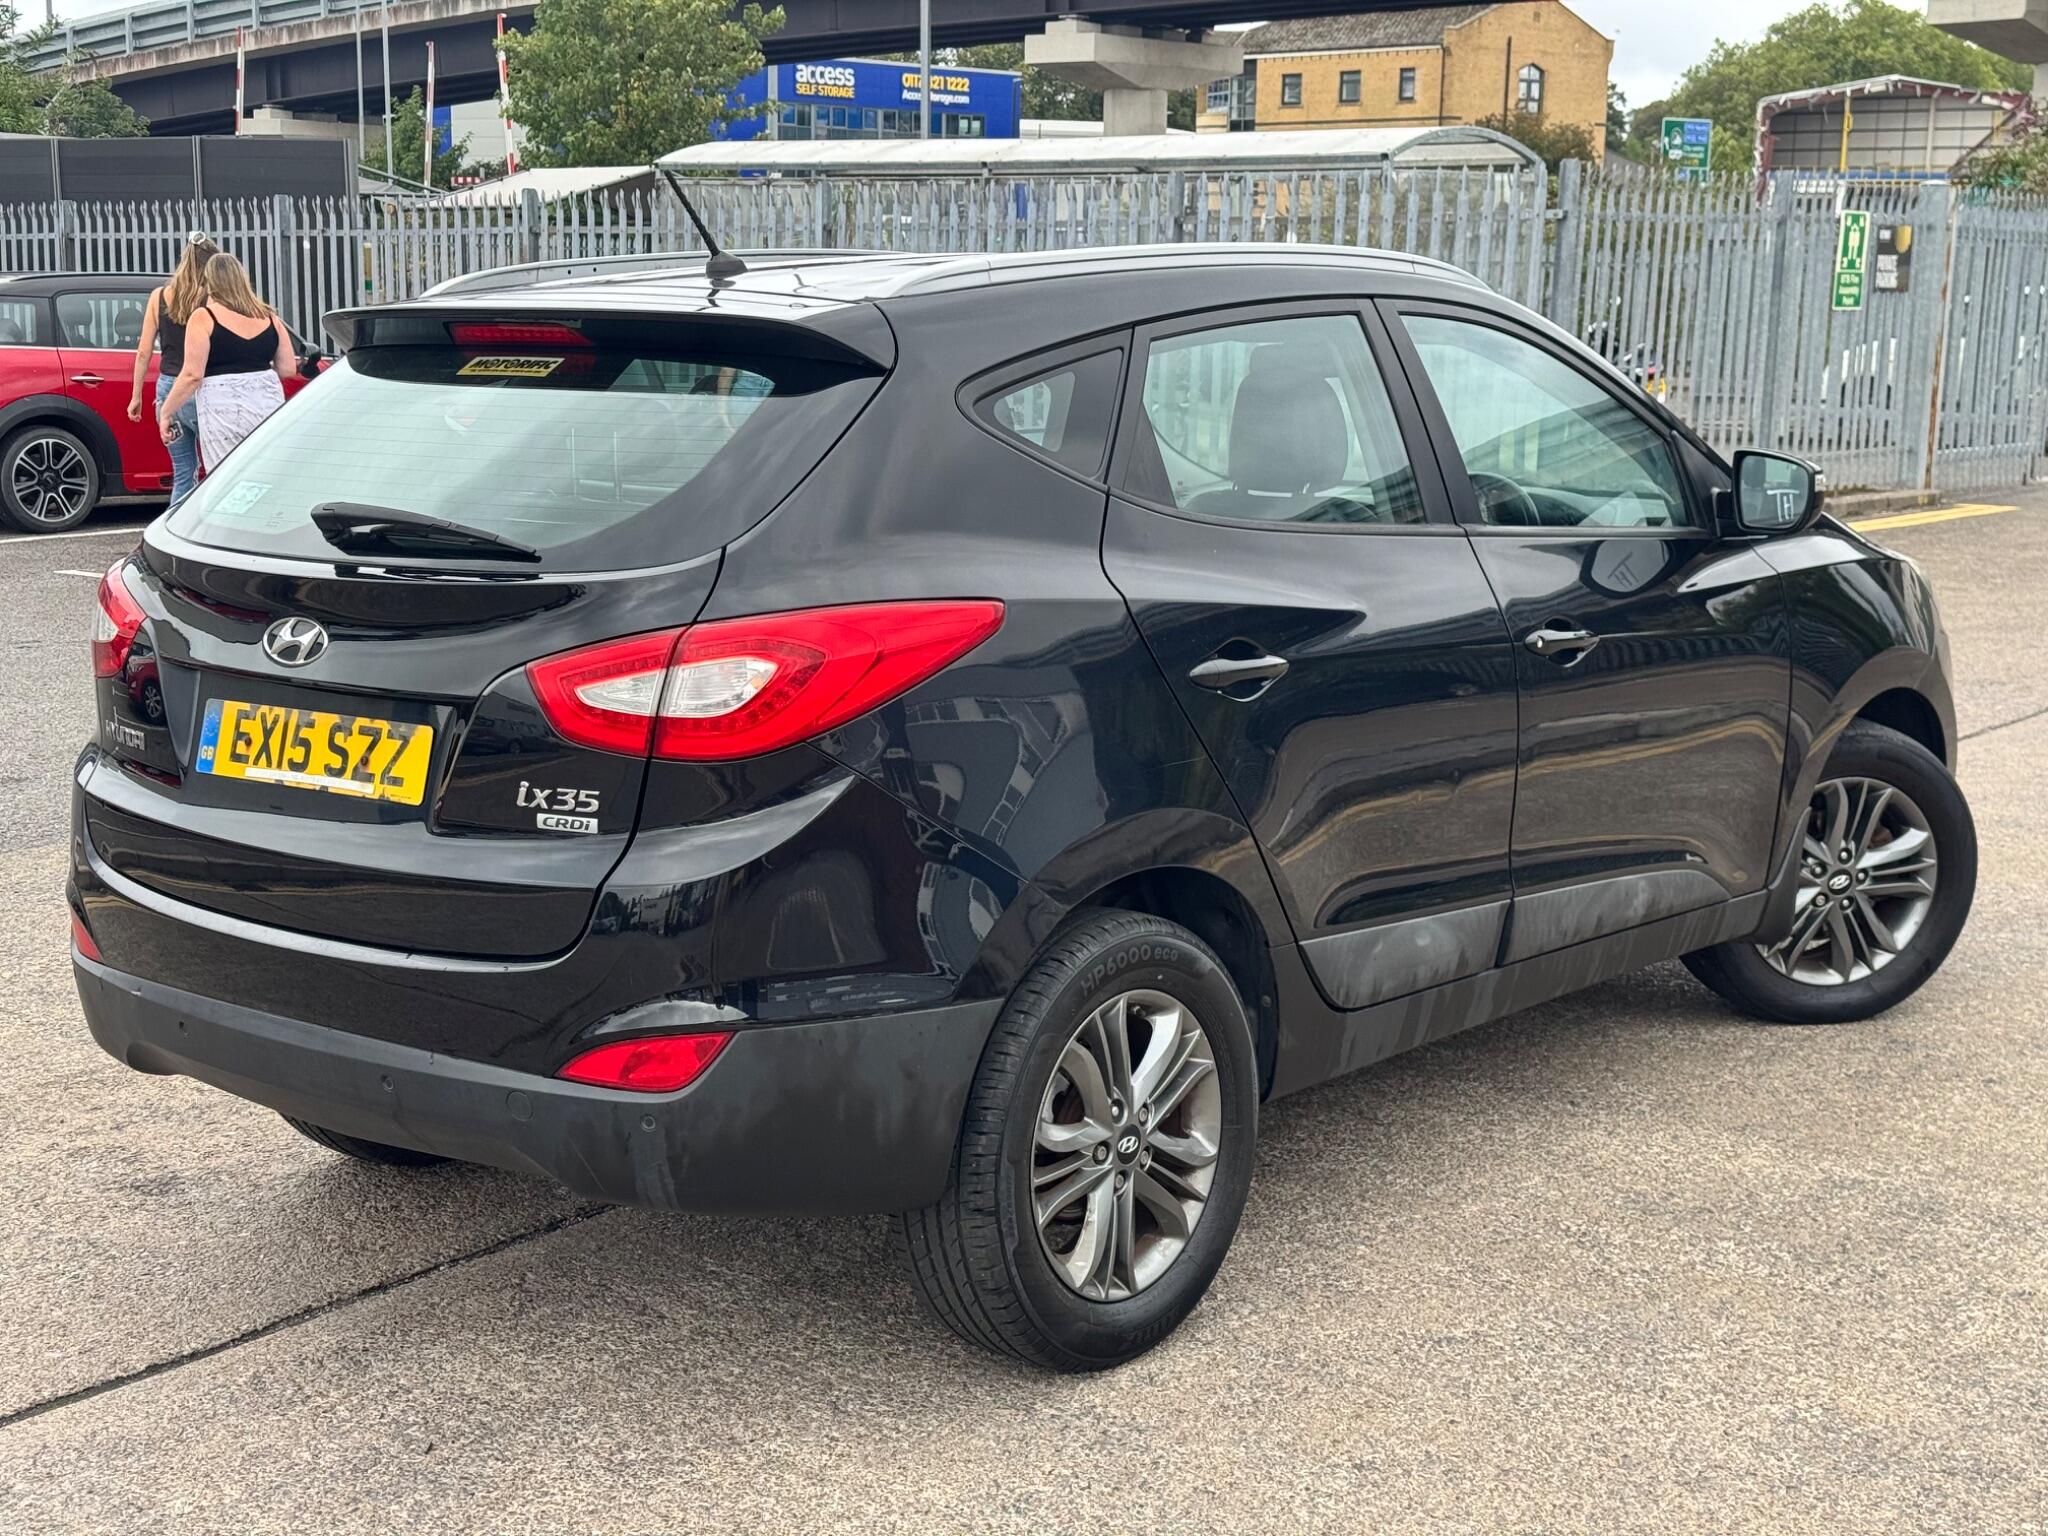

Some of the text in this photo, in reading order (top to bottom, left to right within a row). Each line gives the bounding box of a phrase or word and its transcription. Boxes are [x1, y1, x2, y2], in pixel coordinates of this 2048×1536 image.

[795, 64, 855, 85] access
[945, 76, 970, 92] 1222
[796, 83, 855, 98] SELF STORAGE
[200, 709, 410, 788] GB EX15 SZZ
[516, 781, 600, 813] ix35
[542, 816, 591, 831] CRDi
[1081, 944, 1178, 997] HP6000 eco
